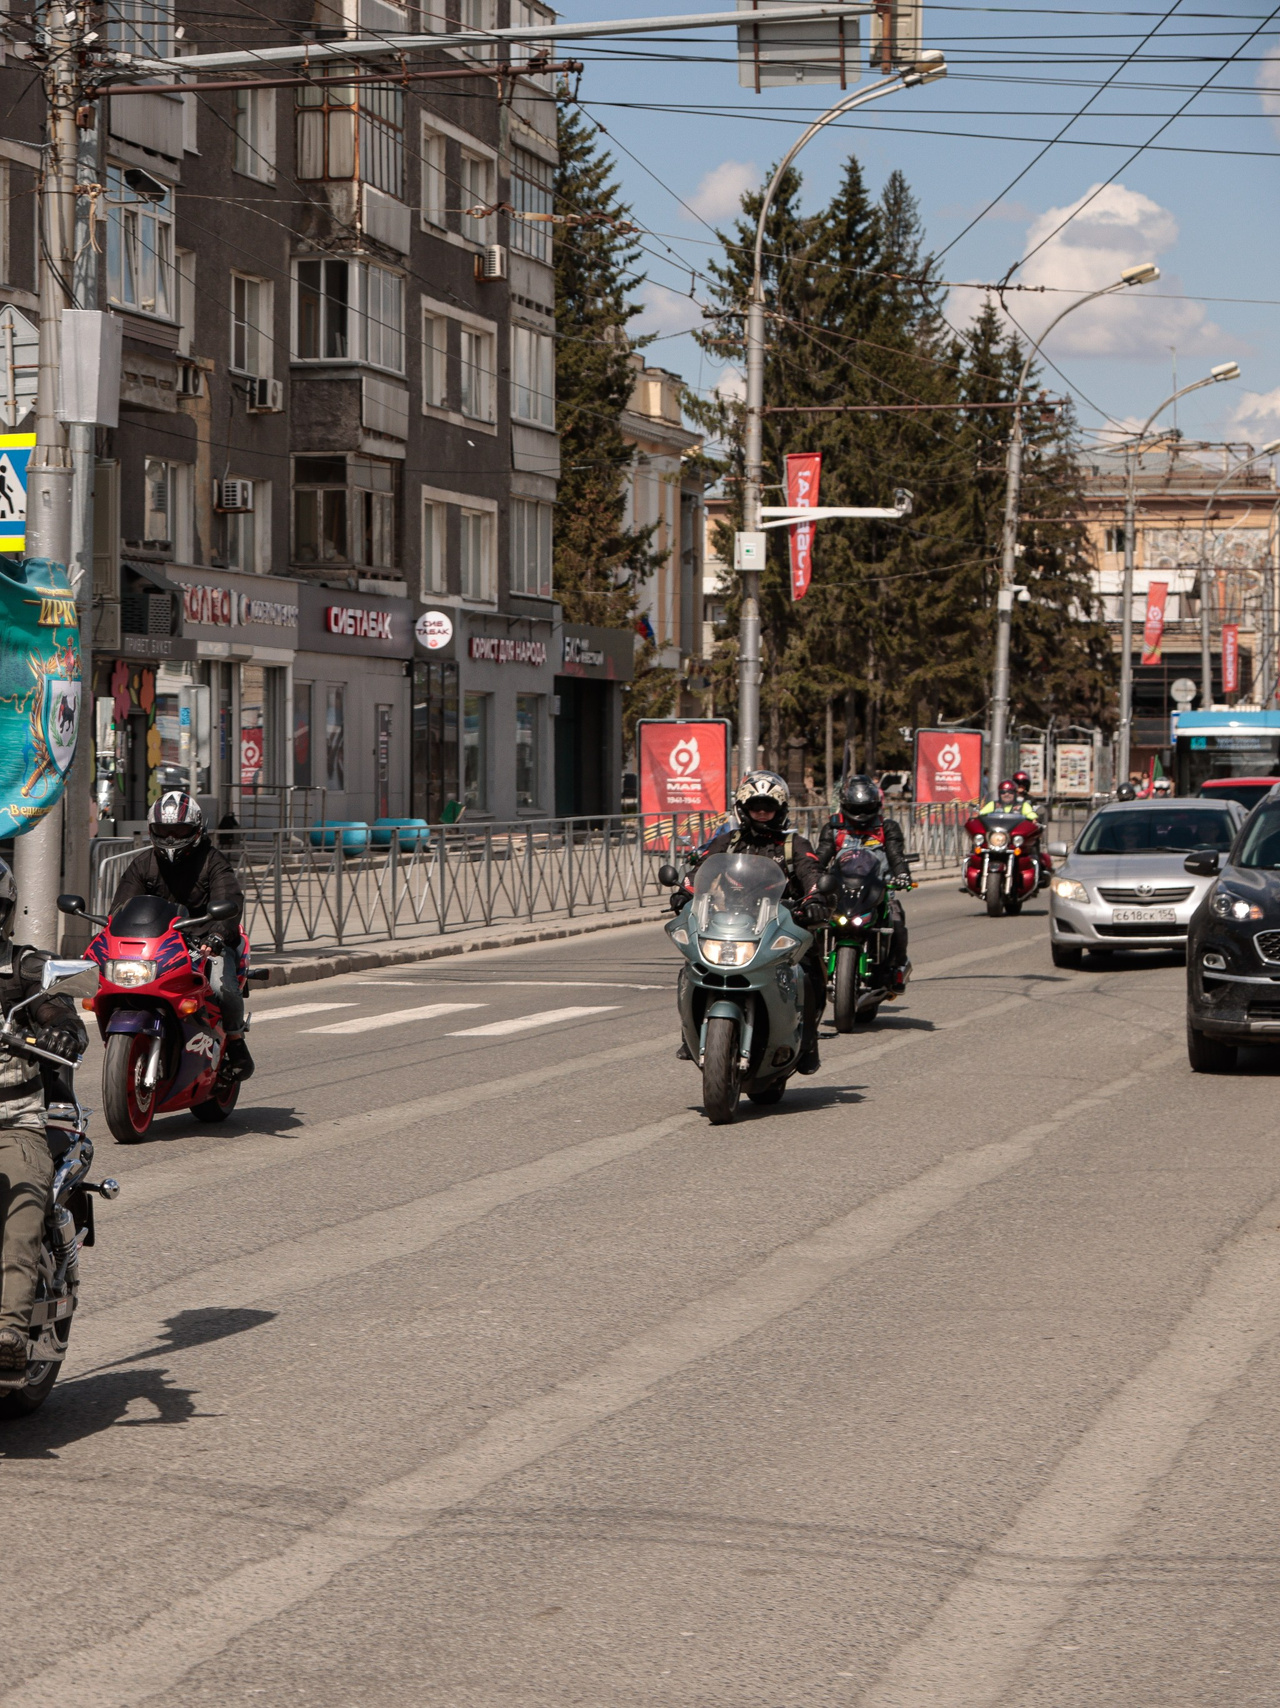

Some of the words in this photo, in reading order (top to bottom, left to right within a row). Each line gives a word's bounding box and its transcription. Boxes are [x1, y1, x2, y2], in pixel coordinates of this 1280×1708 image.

[328, 606, 393, 639] СИБТАБАК
[422, 620, 444, 628] СИБ
[415, 628, 450, 636] ТАБАК
[472, 637, 498, 659] ЮРИСТ
[498, 639, 515, 664] ДЛЯ
[515, 641, 548, 667] НАРОДА
[675, 748, 693, 776] 9
[942, 750, 955, 771] 9
[666, 783, 702, 791] МАЯ
[666, 796, 702, 804] 1941-1945
[1116, 910, 1155, 921] С618СК
[1158, 909, 1174, 918] 154
